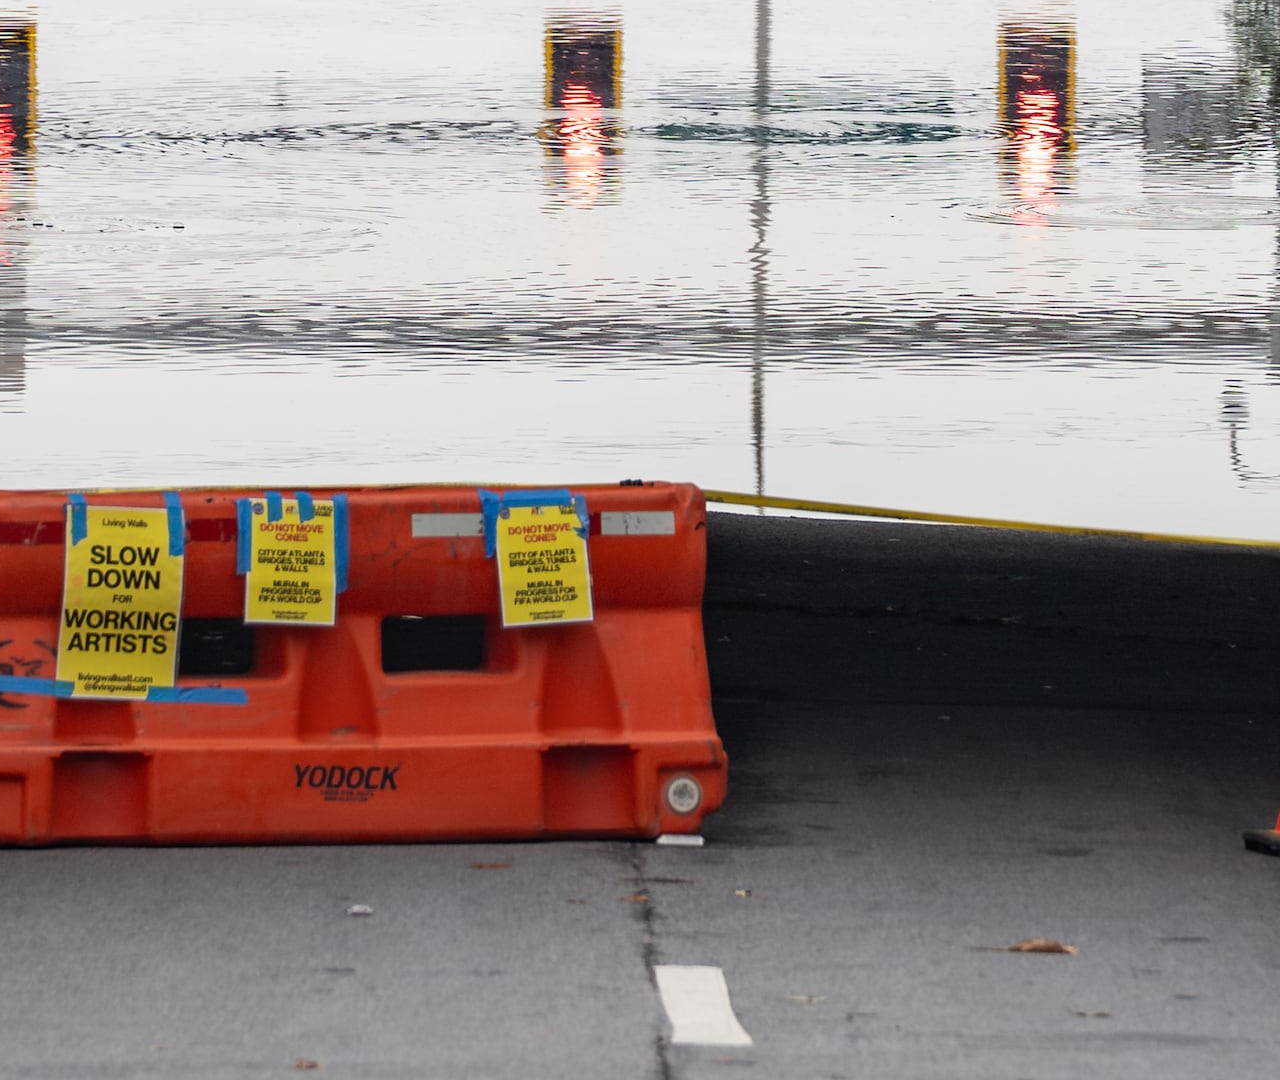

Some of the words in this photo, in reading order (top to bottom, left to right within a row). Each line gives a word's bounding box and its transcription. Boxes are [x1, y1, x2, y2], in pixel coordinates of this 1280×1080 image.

[102, 518, 125, 528] Living
[128, 519, 148, 528] Walls
[260, 523, 274, 532] DO
[276, 523, 295, 532] NOT
[297, 524, 324, 533] MOVE
[508, 526, 522, 535] DO
[523, 524, 542, 534] NOT
[544, 522, 571, 532] MOVE
[275, 533, 308, 542] CONES
[524, 534, 557, 543] CONES
[90, 545, 160, 566] SLOW
[258, 549, 277, 557] CITY
[277, 549, 287, 557] OF
[289, 550, 325, 558] ATLANTA
[509, 551, 527, 559] CITY
[528, 550, 538, 558] OF
[540, 548, 576, 557] ATLANTA
[282, 565, 308, 573] WALLS
[534, 563, 560, 572] WALLS
[87, 568, 161, 590] DOWN
[273, 580, 299, 588] MURAL
[527, 580, 553, 588] MURAL
[261, 587, 304, 595] PROGRESS
[305, 588, 321, 596] FOR
[515, 588, 558, 597] PROGRESS
[560, 586, 576, 594] FOR
[113, 594, 133, 604] FOR
[258, 595, 276, 603] FIFA
[277, 595, 305, 604] WORLD
[306, 596, 322, 605] CUP
[514, 597, 531, 606] FIFA
[533, 595, 560, 604] WORLD
[562, 593, 578, 602] CUP
[65, 608, 177, 631] WORKING
[67, 632, 168, 654] ARTISTS
[295, 764, 400, 790] YODOCK
